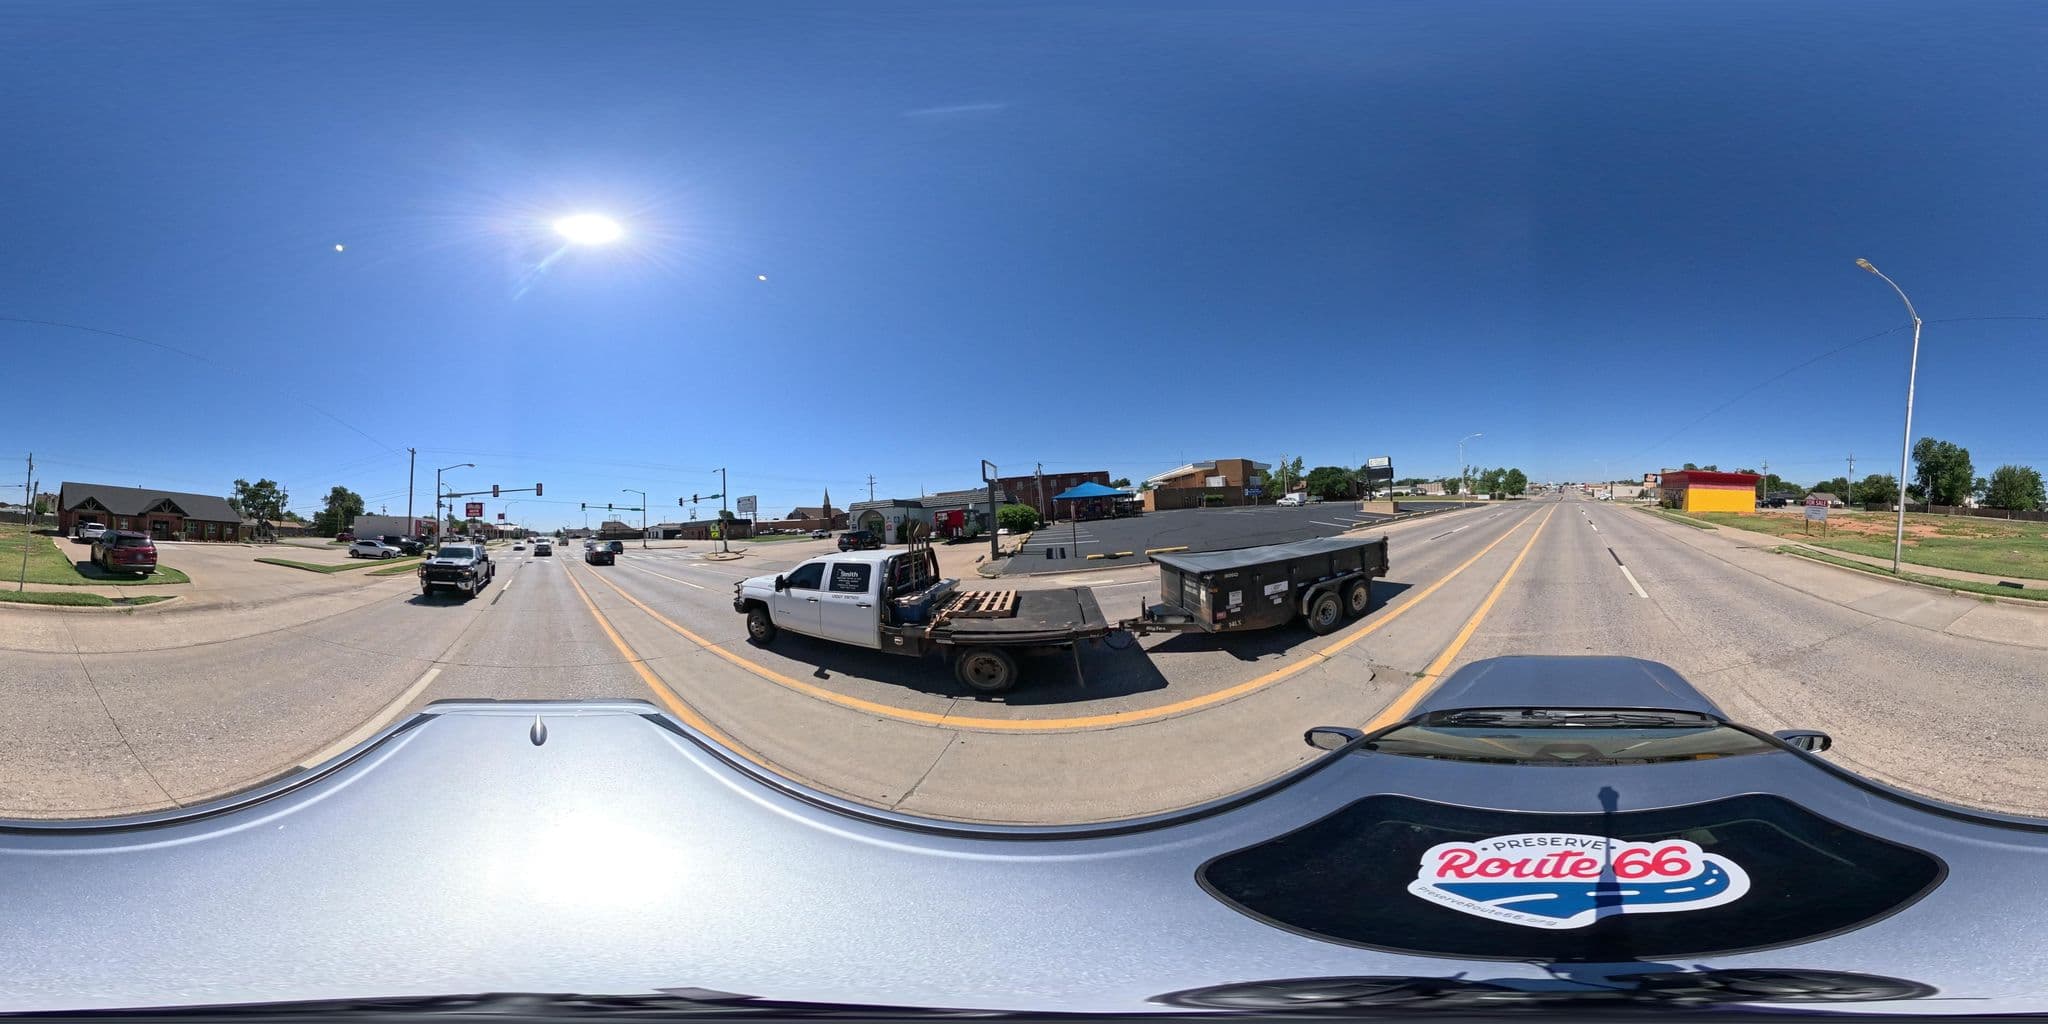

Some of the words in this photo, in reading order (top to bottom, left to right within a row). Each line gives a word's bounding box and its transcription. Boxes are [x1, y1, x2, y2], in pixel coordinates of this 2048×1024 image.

[1493, 837, 1608, 851] PRESERVE
[1436, 848, 1604, 879] Route
[1613, 845, 1692, 879] 66
